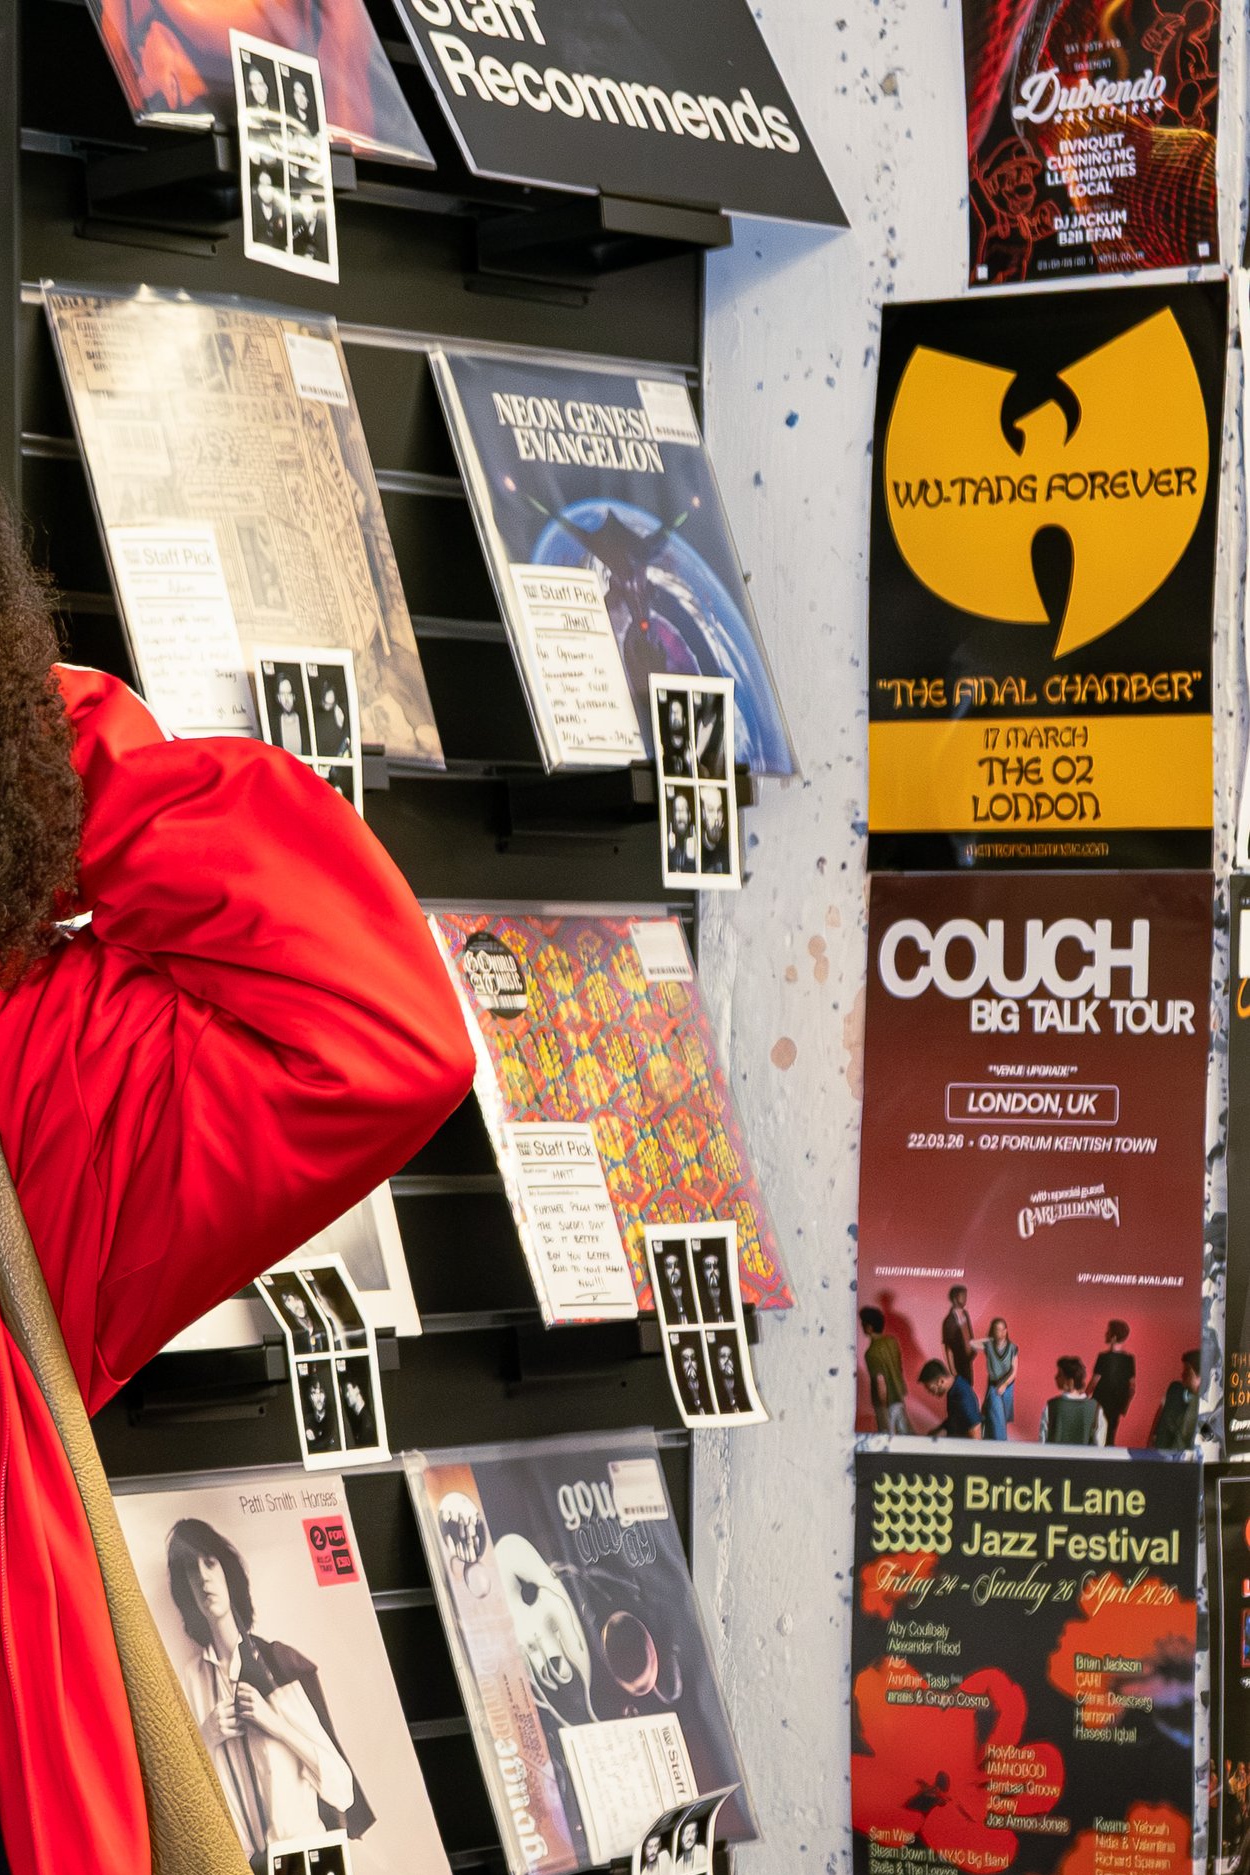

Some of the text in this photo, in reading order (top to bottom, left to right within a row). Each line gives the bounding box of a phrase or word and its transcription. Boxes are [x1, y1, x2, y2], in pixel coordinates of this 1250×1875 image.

[428, 30, 801, 154] Recommends
[1012, 67, 1167, 124] Dubtendo
[1046, 145, 1137, 171] CUNNING MC
[1068, 180, 1114, 199] LOCAL
[1053, 216, 1070, 231] DJ
[1071, 208, 1128, 230] JACKUM
[492, 392, 655, 441] NEON GENESI
[512, 426, 666, 474] EVANGELION
[893, 466, 1198, 509] WU-TANG FOREVER
[143, 548, 215, 567] Staff Pick
[540, 585, 600, 605] Staff Pick
[954, 676, 1038, 706] FINAL
[1044, 671, 1203, 704] CHAMBER"
[984, 726, 1089, 751] 17 MARCH
[977, 756, 1044, 786] THE
[972, 791, 1102, 823] LONDON
[492, 954, 518, 973] WORLD
[879, 918, 1150, 999] COUCH
[970, 999, 1196, 1035] BIG TALK TOUR
[968, 1092, 1100, 1118] LONDON, UK
[533, 1140, 595, 1157] Staff Pick
[907, 1133, 964, 1149] 22.03.26
[1001, 1135, 1053, 1150] FORUM
[1054, 1136, 1113, 1152] KENTISH
[1114, 1138, 1158, 1154] TOWN
[1077, 1272, 1185, 1288] VIP UPGRADES AVAILABLE
[238, 1488, 339, 1515] Patti Smith Horses
[965, 1476, 1147, 1517] Brick Lane
[327, 1529, 345, 1541] FOR
[960, 1522, 1181, 1564] Jazz Festival
[875, 1560, 1179, 1617] Friday 24 Sunday 26 April 2026
[887, 1620, 907, 1639] Aby
[935, 1640, 962, 1656] Flood
[1075, 1654, 1143, 1673] Brian Jackson
[916, 1688, 991, 1709] & Grupo Cosmo
[1025, 1780, 1061, 1798] Groove
[869, 1825, 892, 1842] Sam
[986, 1811, 1069, 1833] Joe Armon-Jones
[869, 1842, 899, 1859] Steam
[900, 1846, 928, 1862] Down
[967, 1851, 982, 1870] Big
[984, 1851, 1010, 1869] Band
[1095, 1850, 1132, 1868] Richard
[896, 1862, 905, 1875] &
